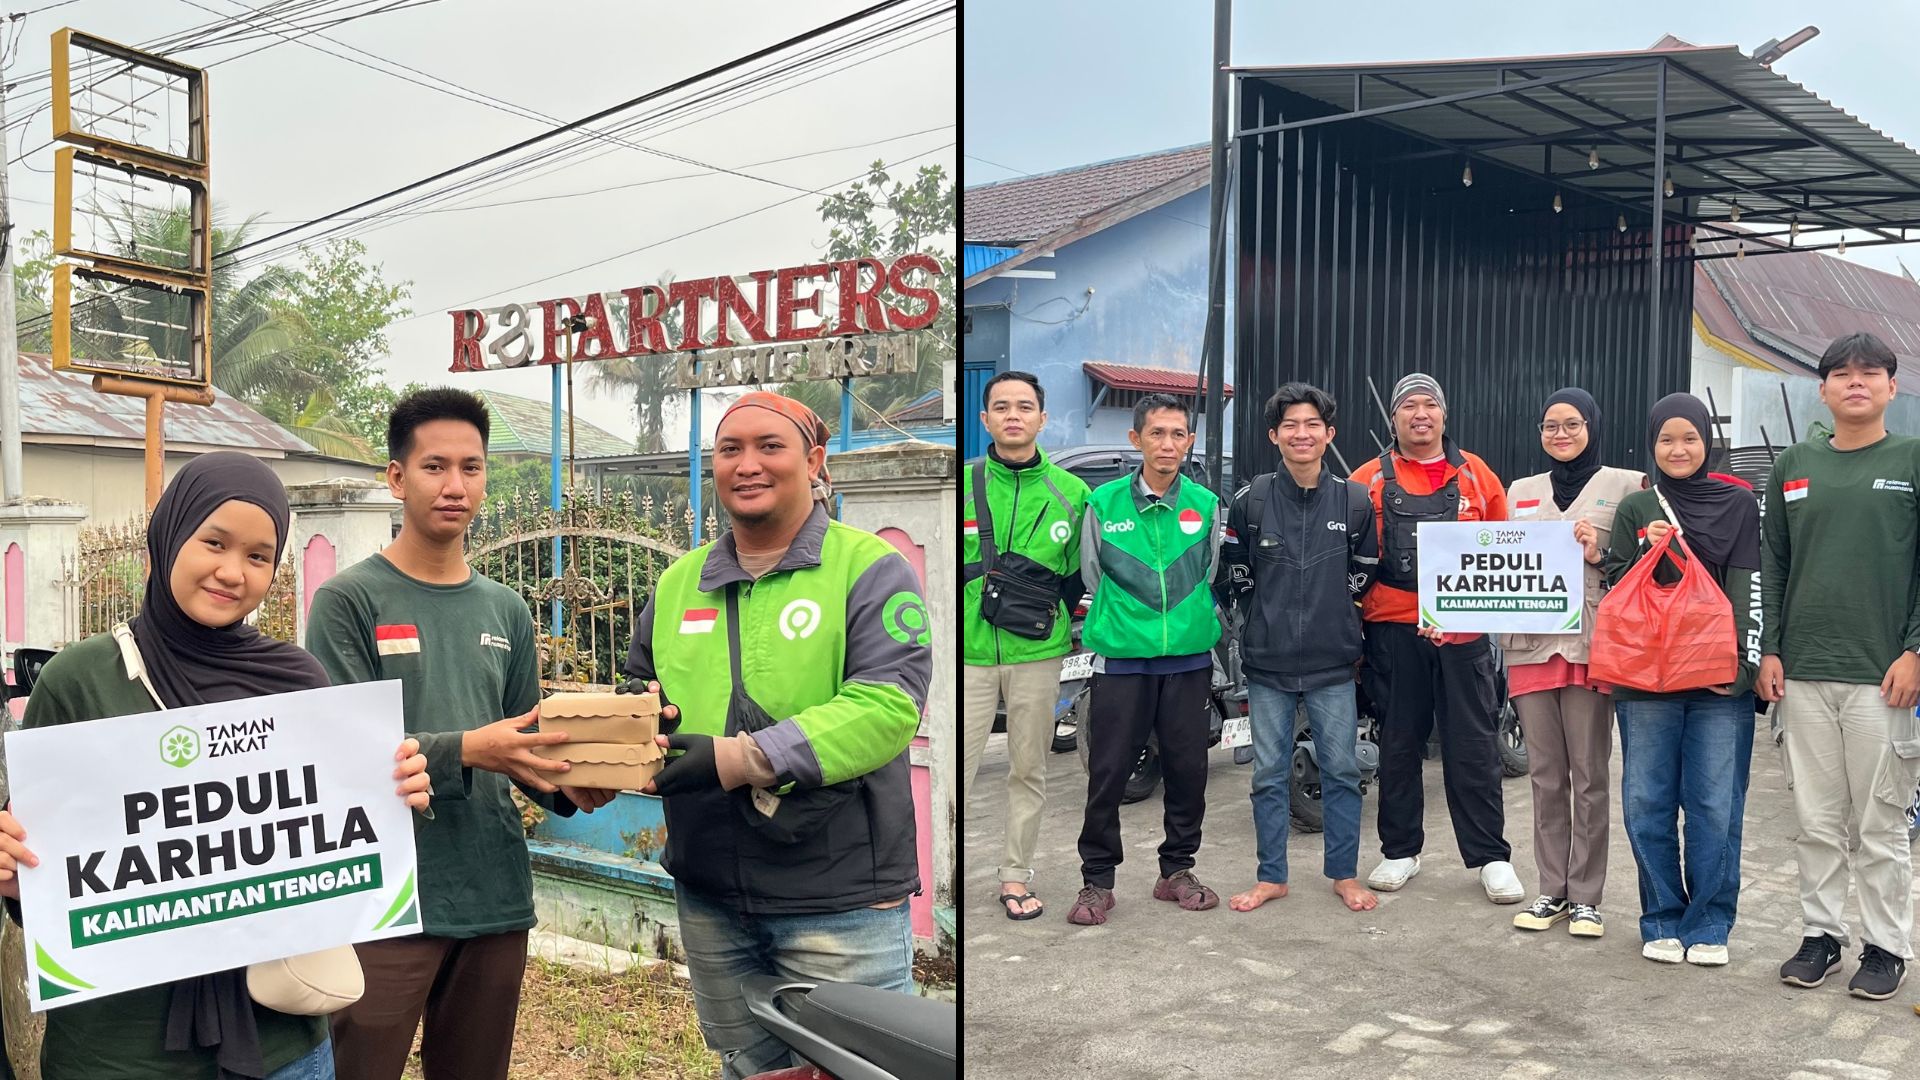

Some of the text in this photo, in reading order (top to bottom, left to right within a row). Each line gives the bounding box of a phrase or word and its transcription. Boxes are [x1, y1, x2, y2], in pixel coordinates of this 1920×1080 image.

[1103, 518, 1135, 533] Grab
[1327, 520, 1347, 532] Gra
[1460, 553, 1543, 571] PEDULI
[1436, 574, 1568, 593] KARHUTLA
[1440, 599, 1564, 609] KALIMANTAN TENGAH
[206, 716, 275, 741] TAMAN
[208, 735, 269, 758] ZAKAT
[123, 764, 319, 836] PEDULI
[65, 805, 380, 899] KARHUTLA
[82, 863, 372, 938] KALIMANTAN TENGAH
